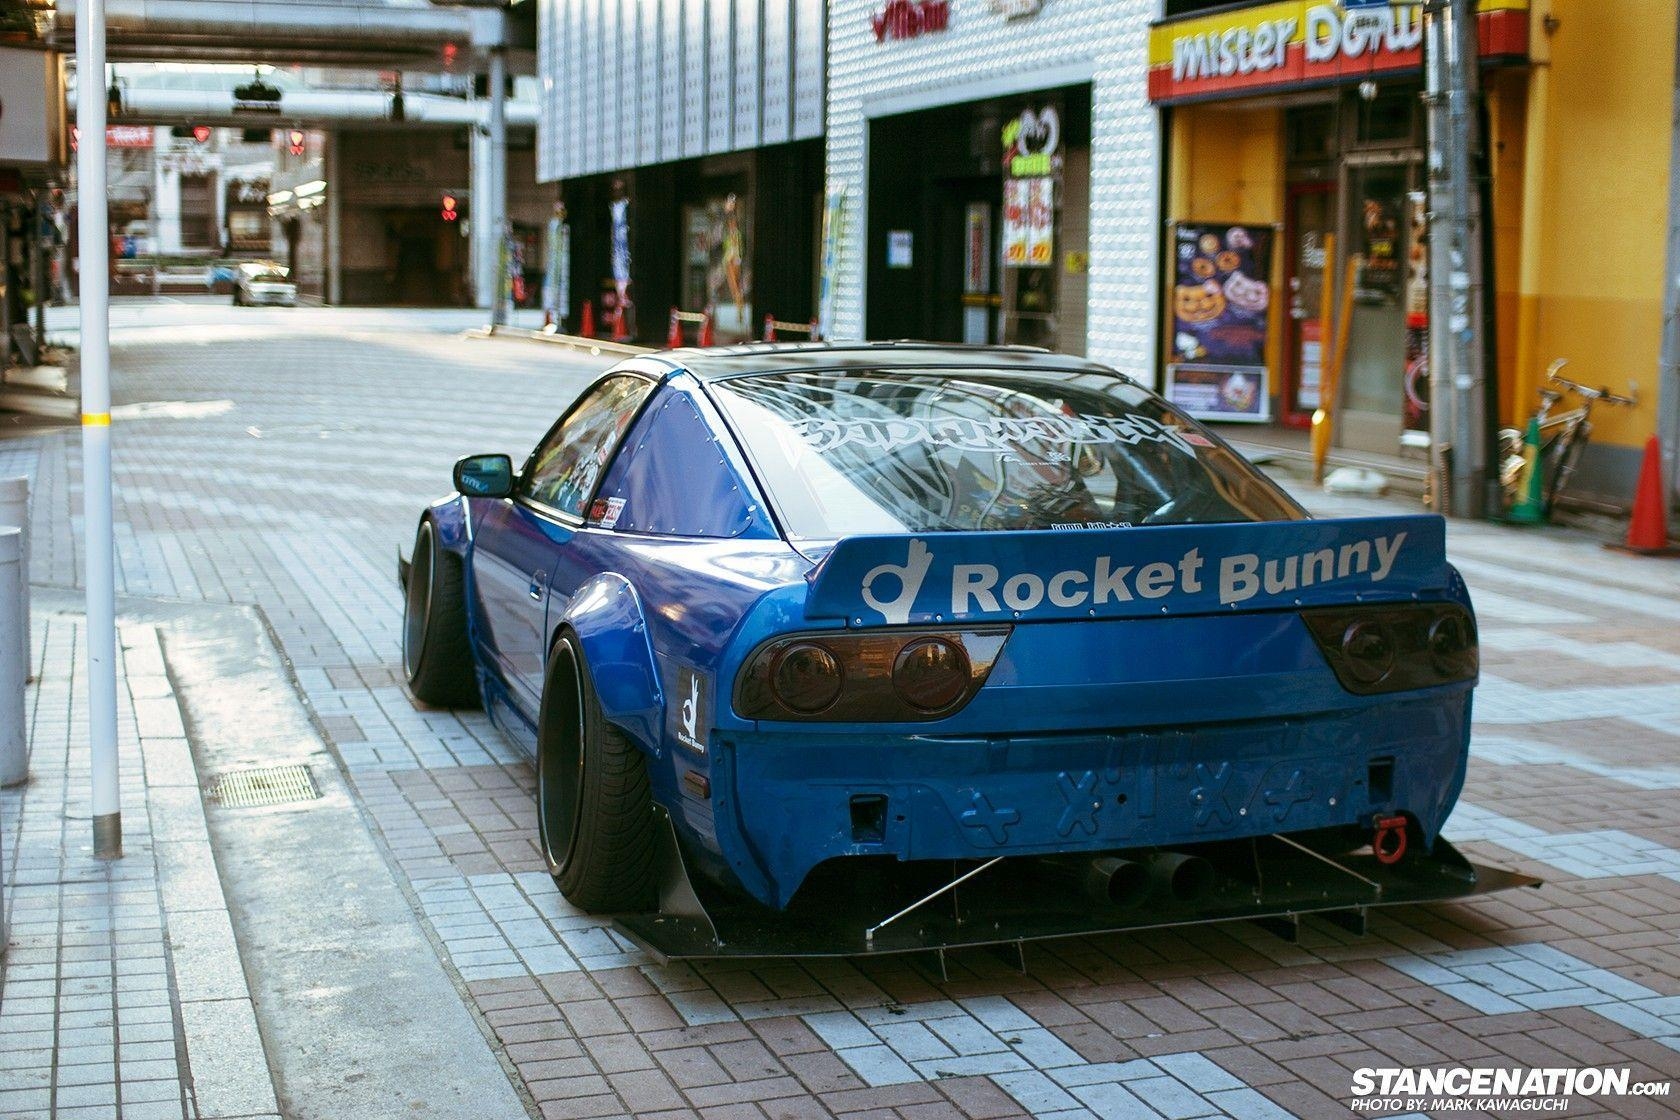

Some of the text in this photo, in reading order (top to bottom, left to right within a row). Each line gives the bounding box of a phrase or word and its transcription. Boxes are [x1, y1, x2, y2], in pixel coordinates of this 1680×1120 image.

[1305, 5, 1422, 63] Donu
[951, 532, 1407, 613] Rocket Bunny
